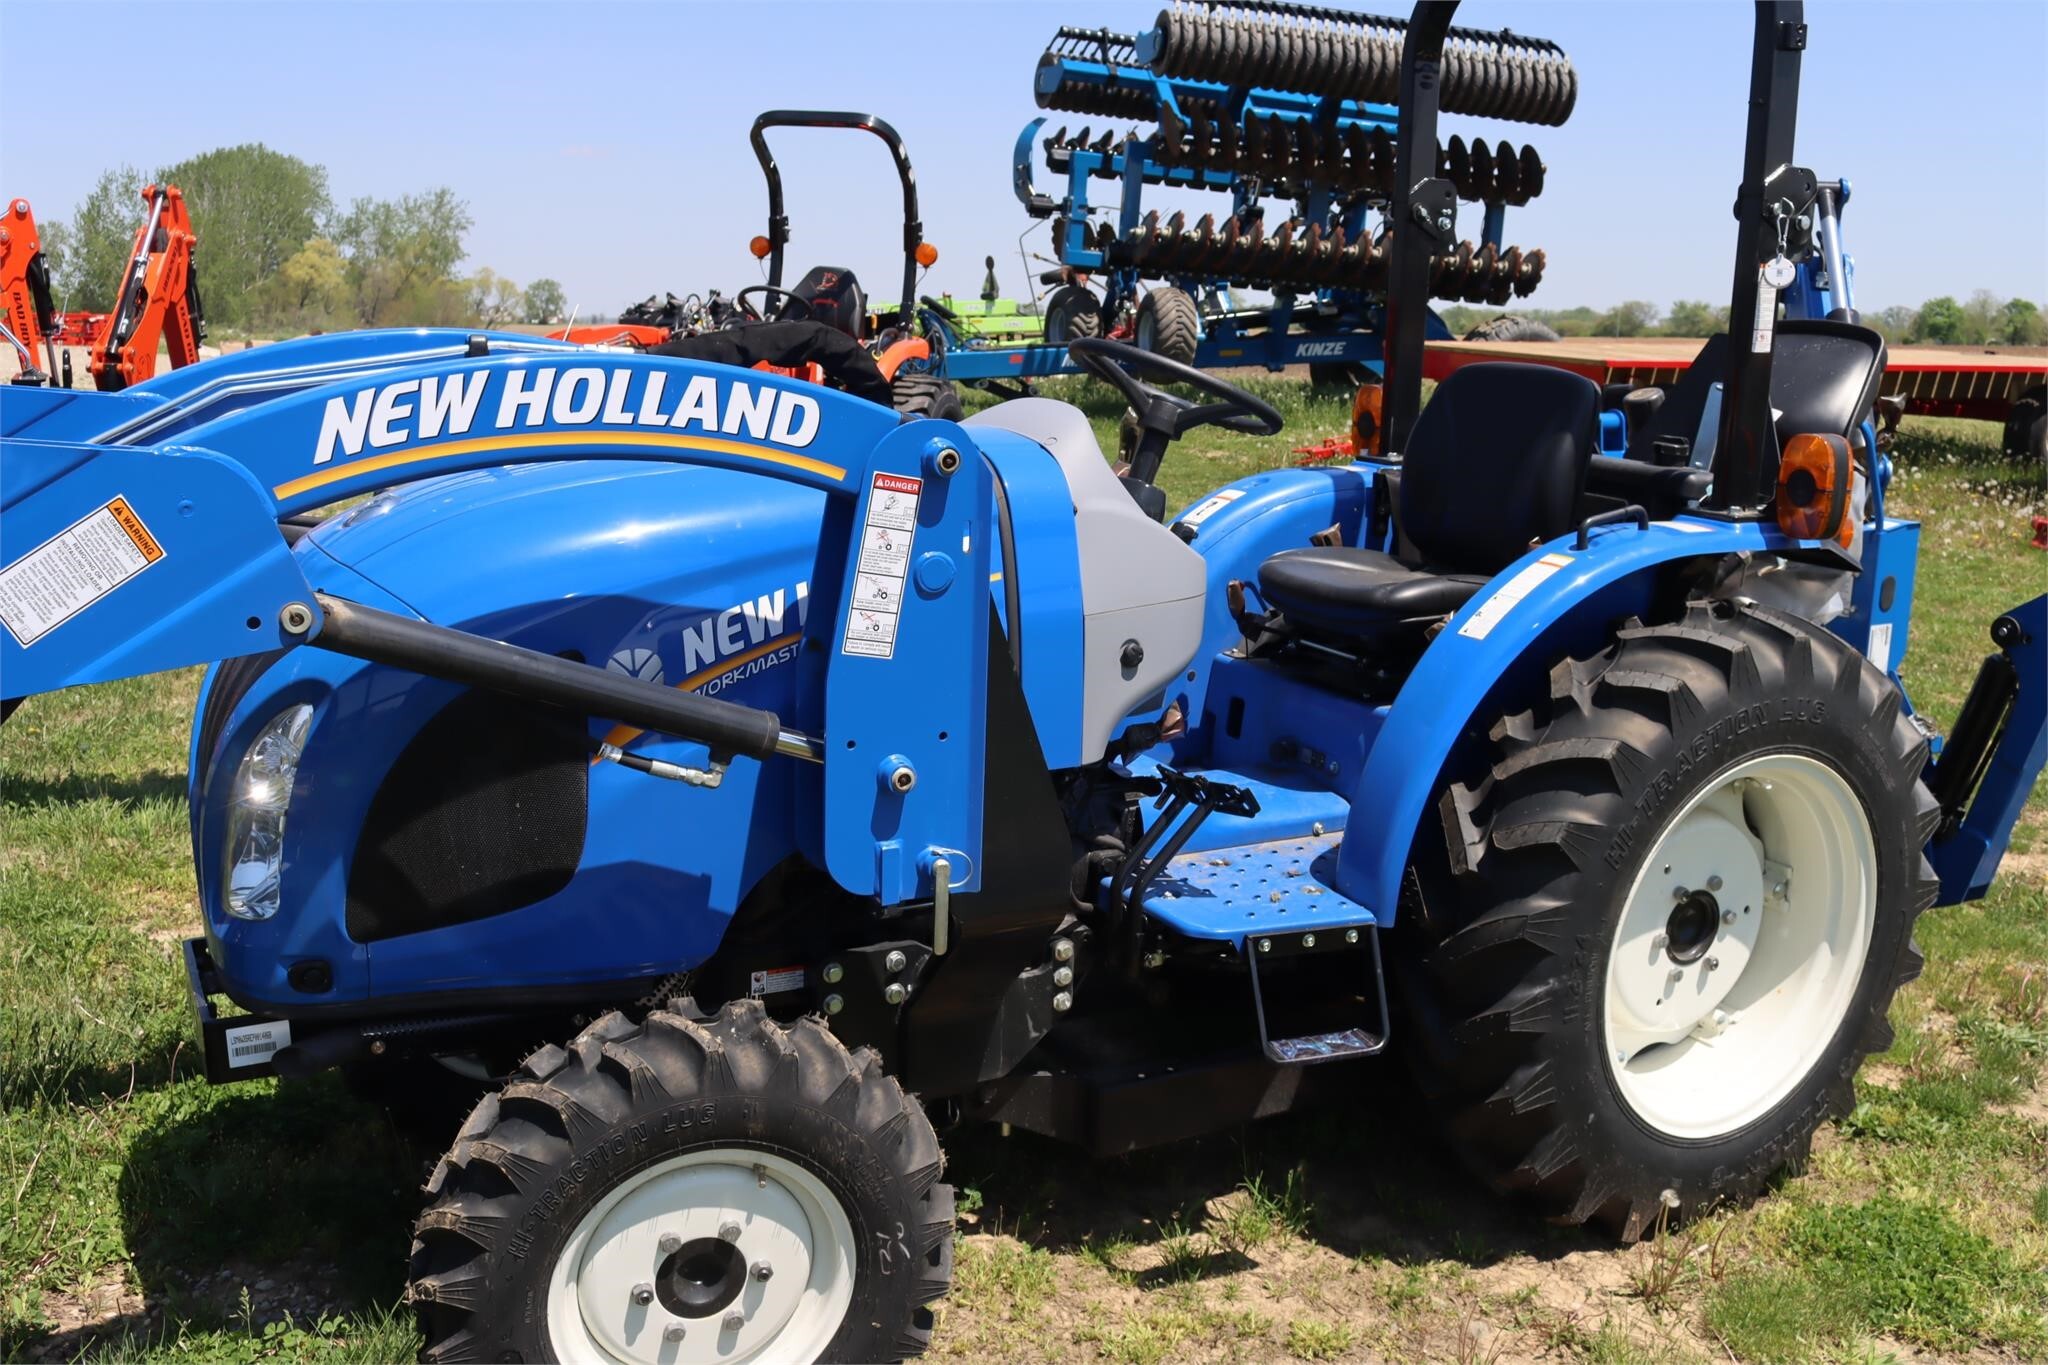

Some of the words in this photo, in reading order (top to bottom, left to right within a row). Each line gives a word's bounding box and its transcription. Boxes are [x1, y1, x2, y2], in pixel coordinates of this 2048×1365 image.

[13, 291, 26, 323] BAD
[19, 321, 32, 349] BOY
[1296, 342, 1347, 357] KINZE
[313, 369, 490, 466] NEW
[495, 367, 822, 449] HOLLAND
[884, 479, 919, 491] DANGER
[123, 514, 155, 556] WARNING
[72, 542, 97, 572] REMOVING
[682, 588, 785, 674] NEW
[694, 643, 800, 697] ORKMAST
[1604, 701, 1769, 872] HI-TRACTION
[506, 1121, 649, 1260] HI-TRACTION
[662, 1102, 717, 1133] LUG
